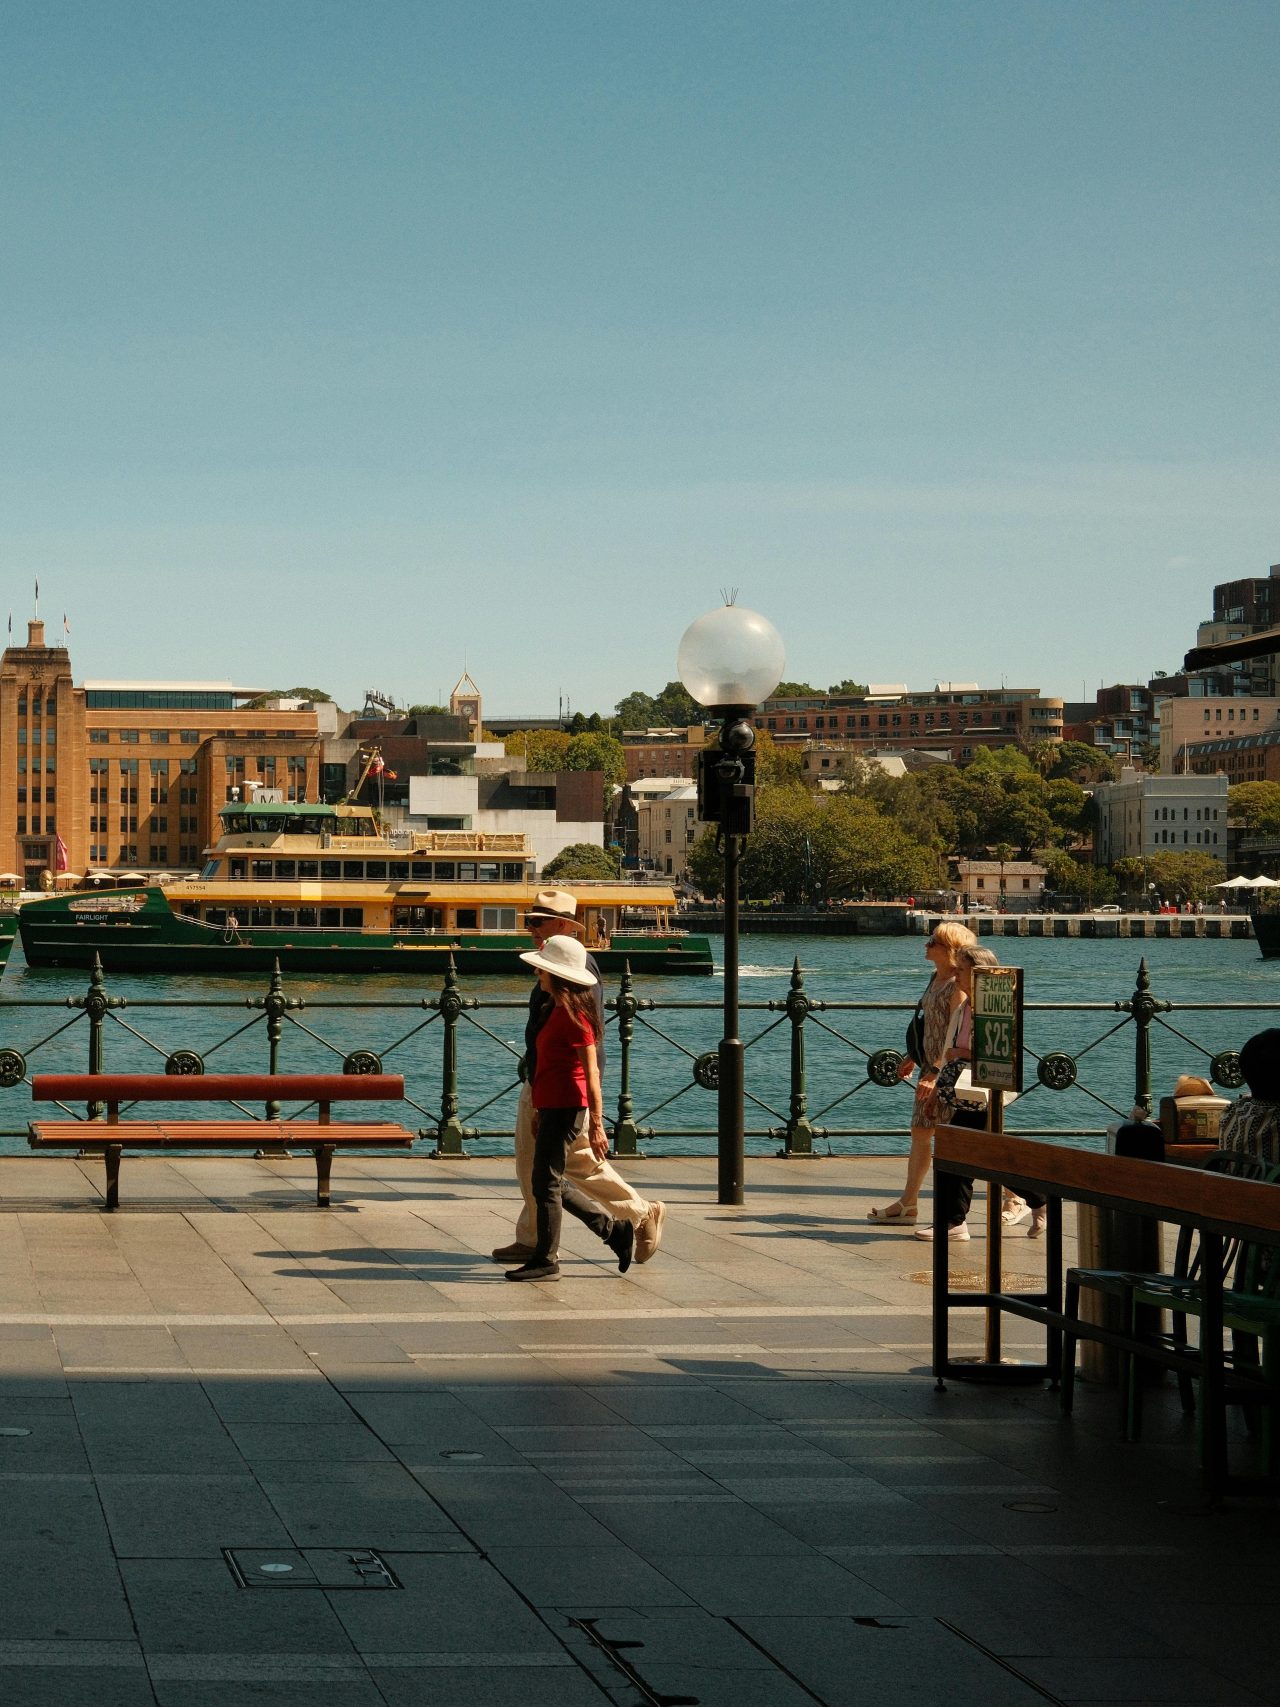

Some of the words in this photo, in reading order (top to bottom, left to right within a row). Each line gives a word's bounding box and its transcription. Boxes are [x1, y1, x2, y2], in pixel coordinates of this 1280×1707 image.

[980, 974, 1012, 993] EXPRES
[983, 993, 1013, 1014] LUNCH
[984, 1020, 1010, 1058] $25
